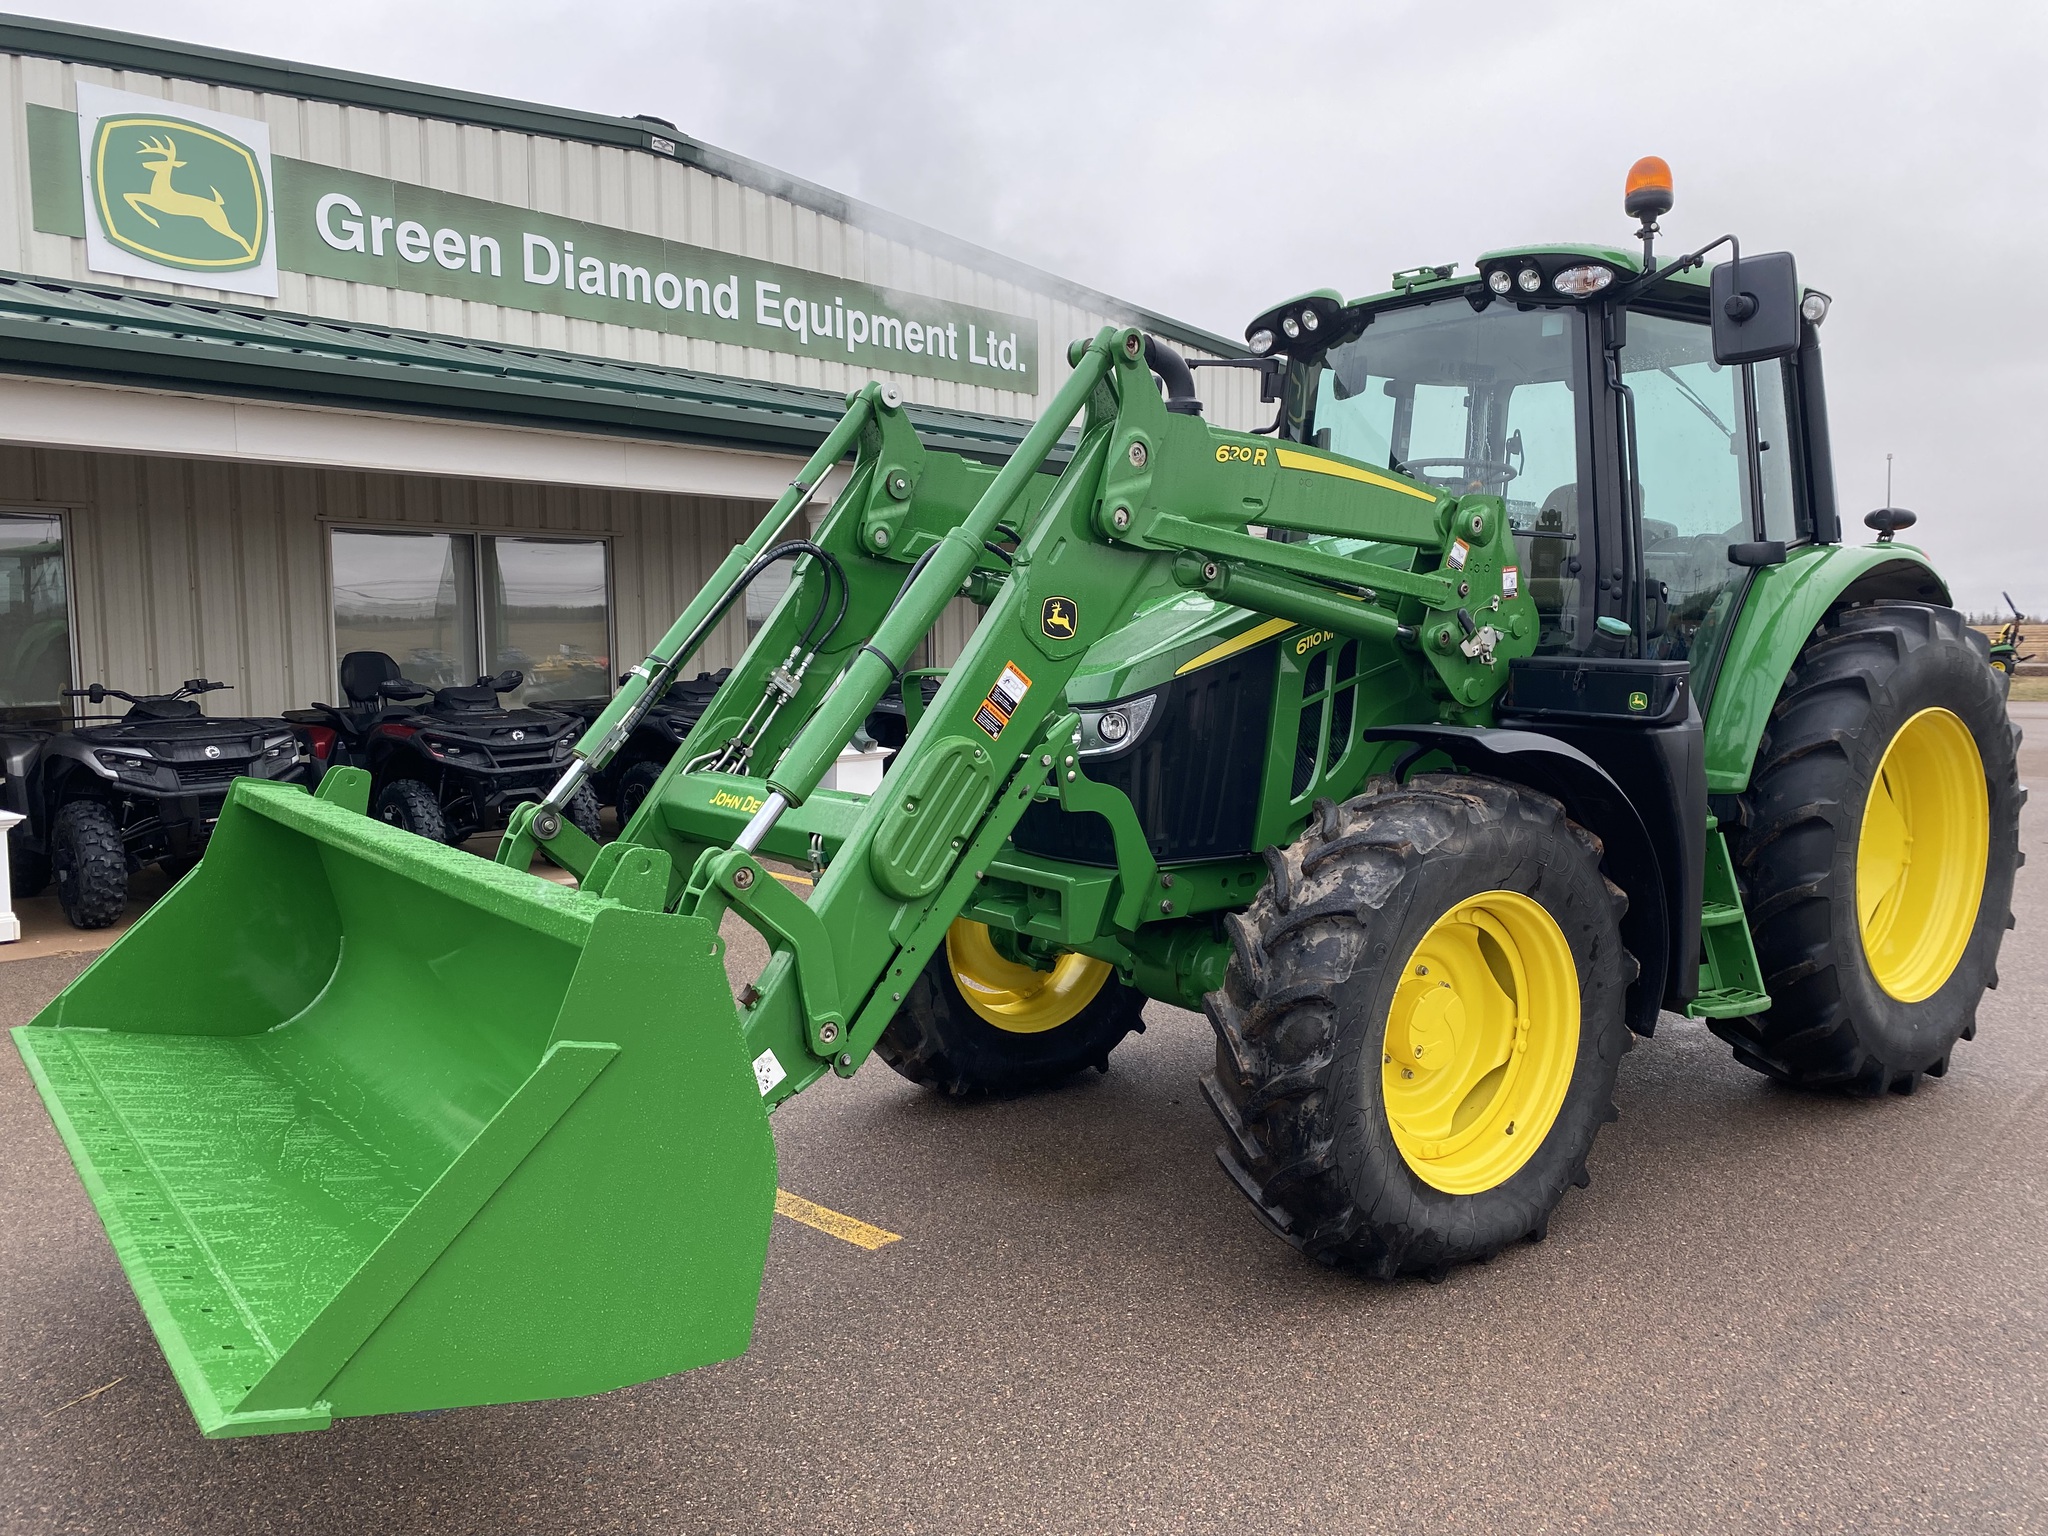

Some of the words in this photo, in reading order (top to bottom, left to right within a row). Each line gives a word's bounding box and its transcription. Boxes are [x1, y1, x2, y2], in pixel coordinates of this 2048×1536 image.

[315, 192, 502, 277] Green
[522, 232, 739, 320] Diamond
[755, 279, 958, 361] Equipment
[968, 323, 1027, 373] Ltd.
[708, 789, 744, 810] JOHN
